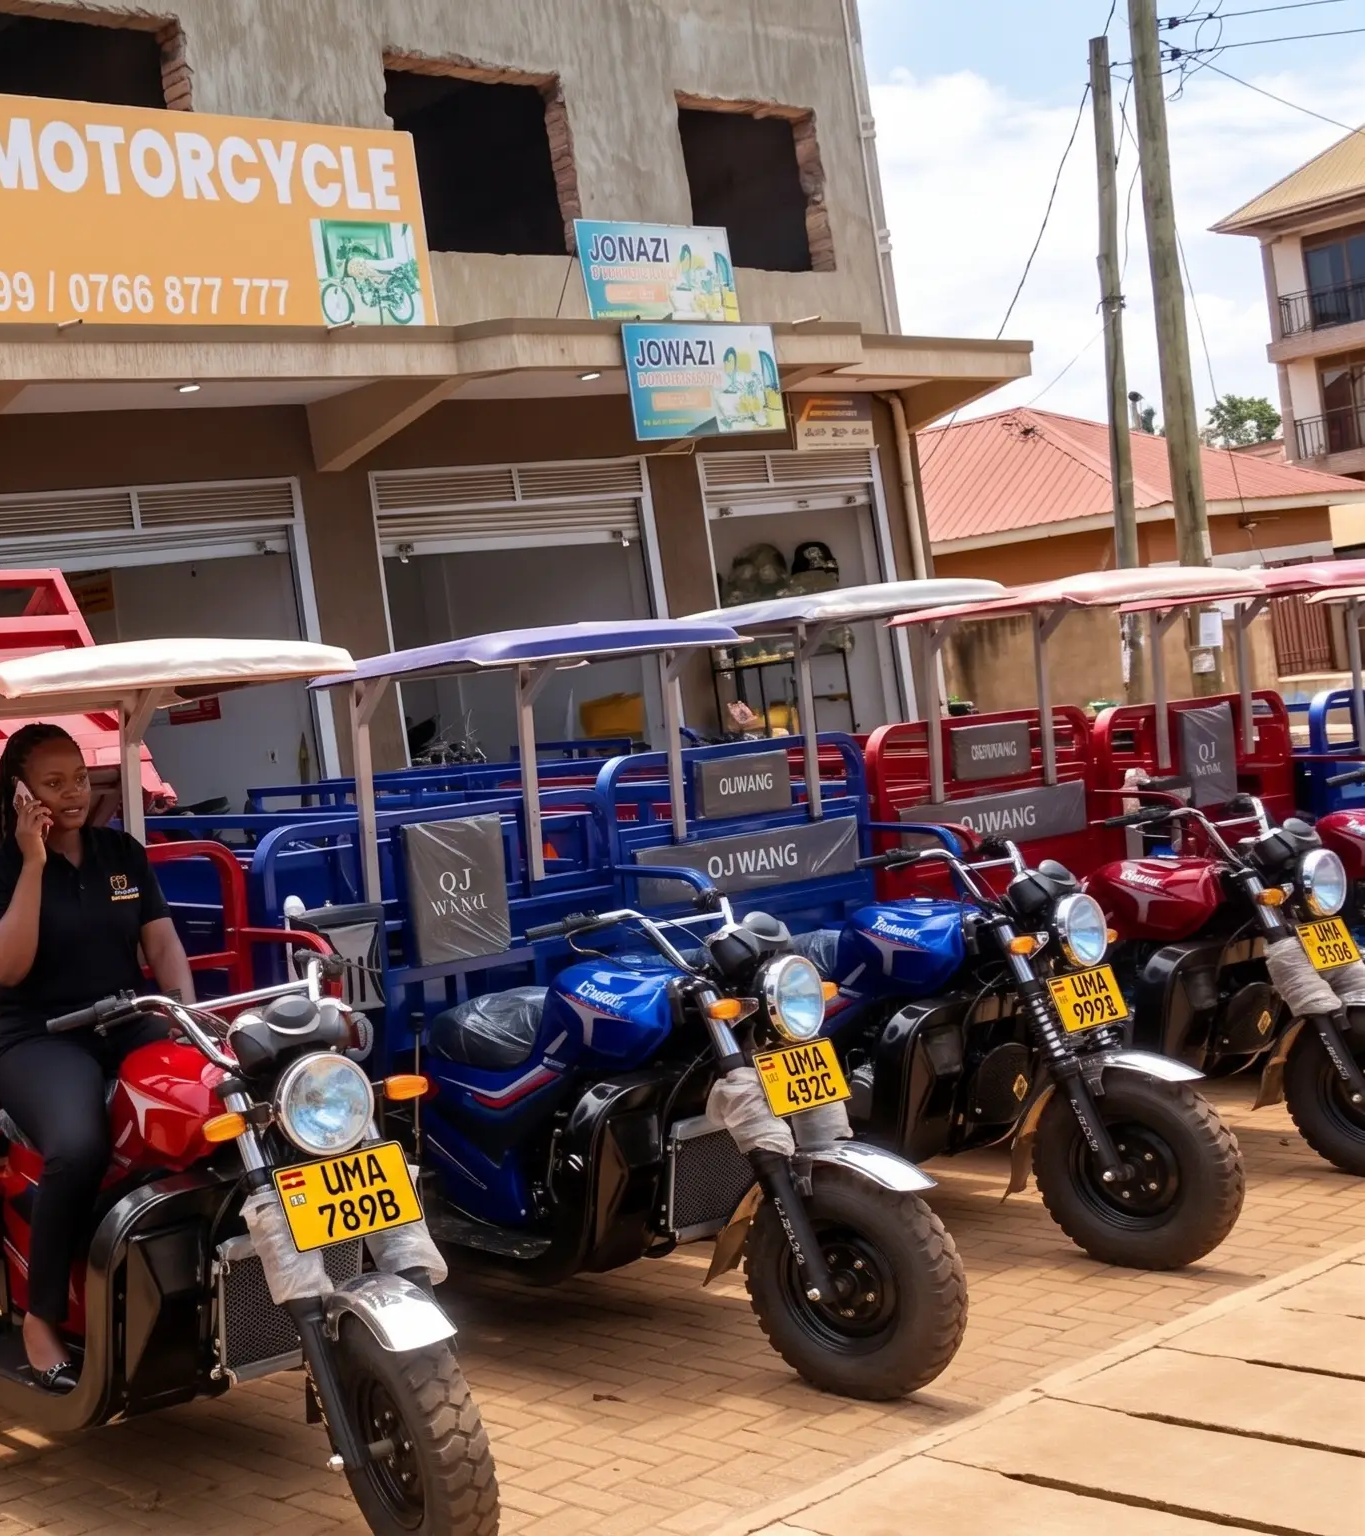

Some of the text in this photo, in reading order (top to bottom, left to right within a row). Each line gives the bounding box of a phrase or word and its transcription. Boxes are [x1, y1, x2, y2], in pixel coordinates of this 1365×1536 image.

[589, 234, 670, 263] JONAZI
[69, 272, 154, 314] 0766
[164, 275, 222, 315] 877
[234, 277, 289, 316] 777
[635, 340, 715, 367] JOWAZI
[1199, 741, 1215, 763] QJ
[719, 773, 773, 795] OUWANG
[439, 868, 472, 897] QJ
[1070, 971, 1109, 998] UMA
[782, 1046, 828, 1076] UMA
[787, 1072, 837, 1105] 492C
[320, 1154, 387, 1196] UMA
[318, 1189, 401, 1237] 789B
